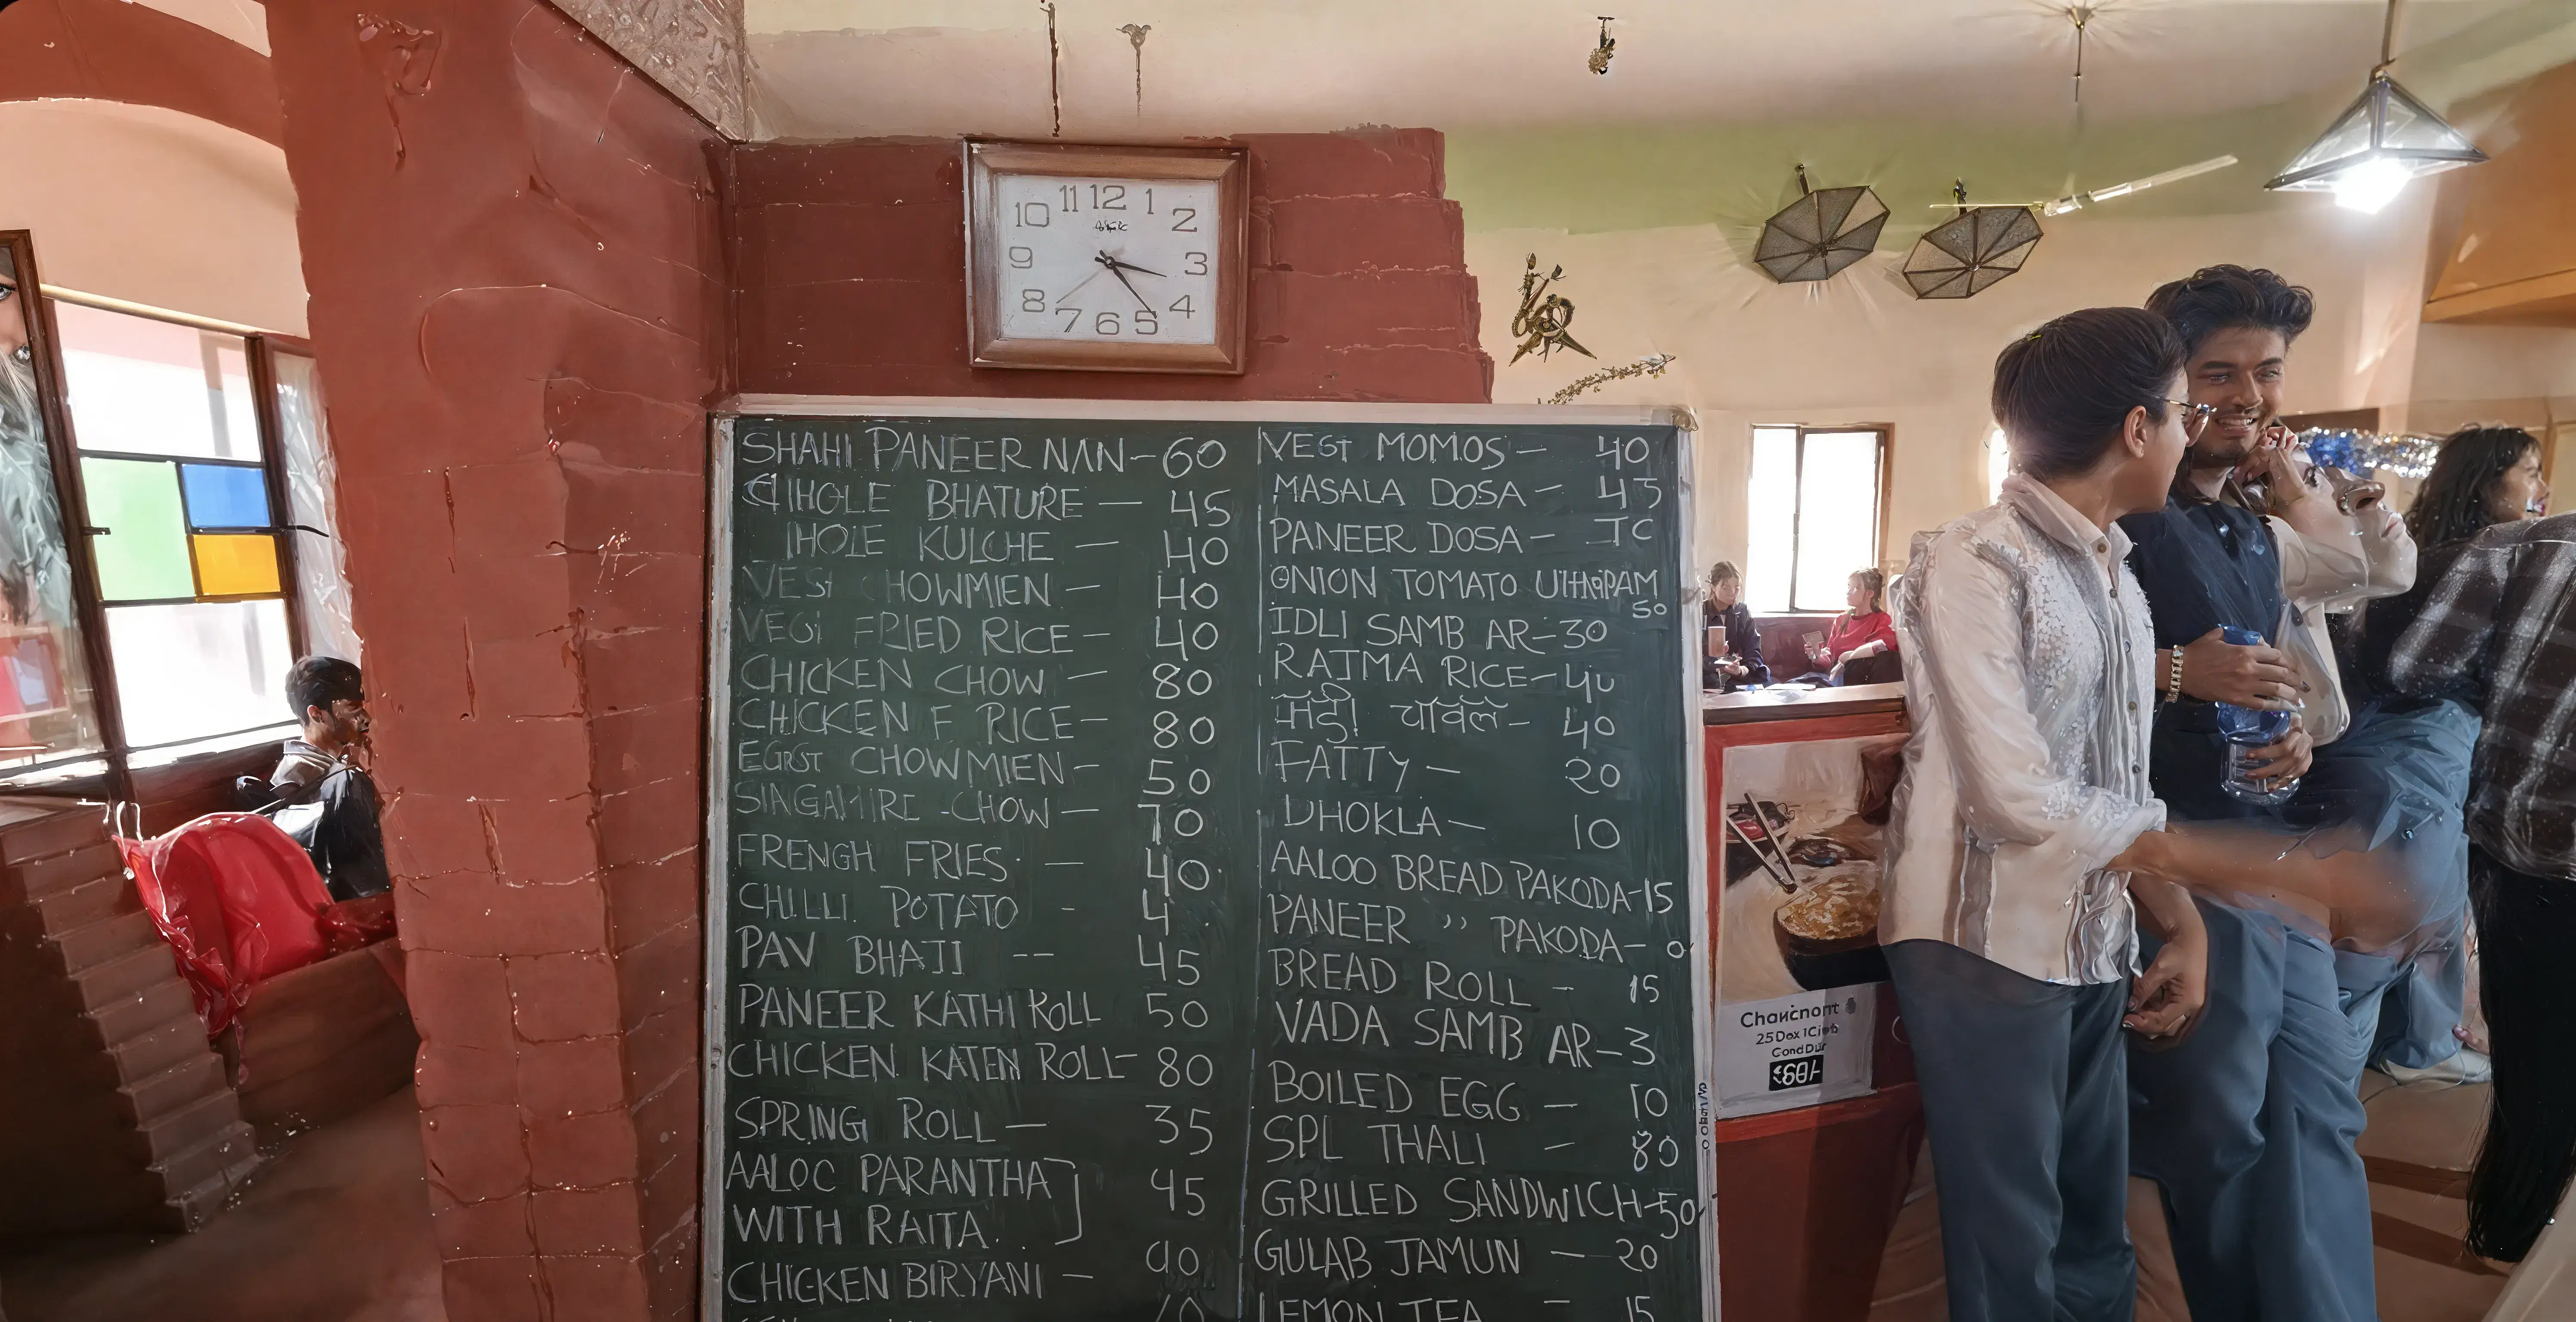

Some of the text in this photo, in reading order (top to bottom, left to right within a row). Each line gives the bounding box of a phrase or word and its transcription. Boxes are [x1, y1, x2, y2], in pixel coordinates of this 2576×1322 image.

[1016, 202, 1197, 232] 10 2
[1090, 185, 1126, 210] 12
[1146, 188, 1154, 214] 1
[1009, 247, 1208, 276] 9 3
[1022, 289, 1195, 318] 8 4
[1056, 308, 1158, 335] 7 6 5
[742, 431, 851, 468] SHAHI
[865, 427, 1031, 472] PANEER
[1163, 437, 1226, 479] 60
[1378, 432, 1505, 470] MOMOS
[1596, 436, 1649, 469] 40
[926, 479, 1083, 521] BHATURE
[1171, 489, 1230, 527] 45
[1273, 473, 1406, 506] MASALA
[1431, 478, 1526, 509] DOSA
[920, 525, 1054, 564] KULCHE
[1269, 518, 1416, 554] PANEER
[1427, 522, 1523, 553] DOSA
[1392, 569, 1517, 601] TOMATO
[982, 617, 1073, 656] RICE
[1156, 616, 1218, 661] 40
[1269, 607, 1346, 639] IDLI
[1560, 619, 1607, 648] 30
[742, 654, 1212, 699] CHICKEN CHOW 80
[1441, 655, 1527, 688] RICE
[740, 698, 1214, 748] CHICKEN F RICE 80
[1563, 707, 1615, 749] 40
[851, 744, 1064, 787] CHOWMIEN
[1143, 759, 1210, 794] 50
[1566, 759, 1620, 794] 20
[952, 791, 1048, 828] CHOW
[1137, 804, 1203, 845] 70
[1575, 815, 1620, 849] 10
[906, 840, 1007, 882] FRIES
[1146, 847, 1209, 897] 40
[1271, 840, 1673, 914] AALOO BREAD PAKODA 15
[880, 886, 1018, 930] POTATO
[1267, 893, 1410, 944] PANEER
[1490, 916, 1623, 963] PAKODA
[736, 925, 815, 968] PAV
[1138, 935, 1199, 985] 45
[1268, 948, 1659, 1006] BREAD ROLL 15
[739, 984, 1208, 1031] PANEER KATHI ROLL 50
[1276, 999, 1389, 1047] VADA
[1415, 1008, 1522, 1060] SAMB
[728, 1041, 895, 1082] CHICKEN
[1035, 1043, 1127, 1080] ROLL
[1158, 1047, 1213, 1087] 80
[1268, 1060, 1412, 1113] BOILED
[1440, 1077, 1520, 1121] EGG
[1630, 1084, 1668, 1121] 10
[735, 1097, 1212, 1155] SPRING ROLL 35
[1264, 1115, 1678, 1172] SPL THALI 80
[861, 1154, 1052, 1200] PARANTHA
[734, 1204, 842, 1245] WITH
[1262, 1177, 1695, 1239] GRILLED SANDWICH 50
[1254, 1229, 1657, 1283] GULAB JAMUN 20
[728, 1262, 889, 1305] CHICKEN
[902, 1260, 1042, 1299] BIRYANI
